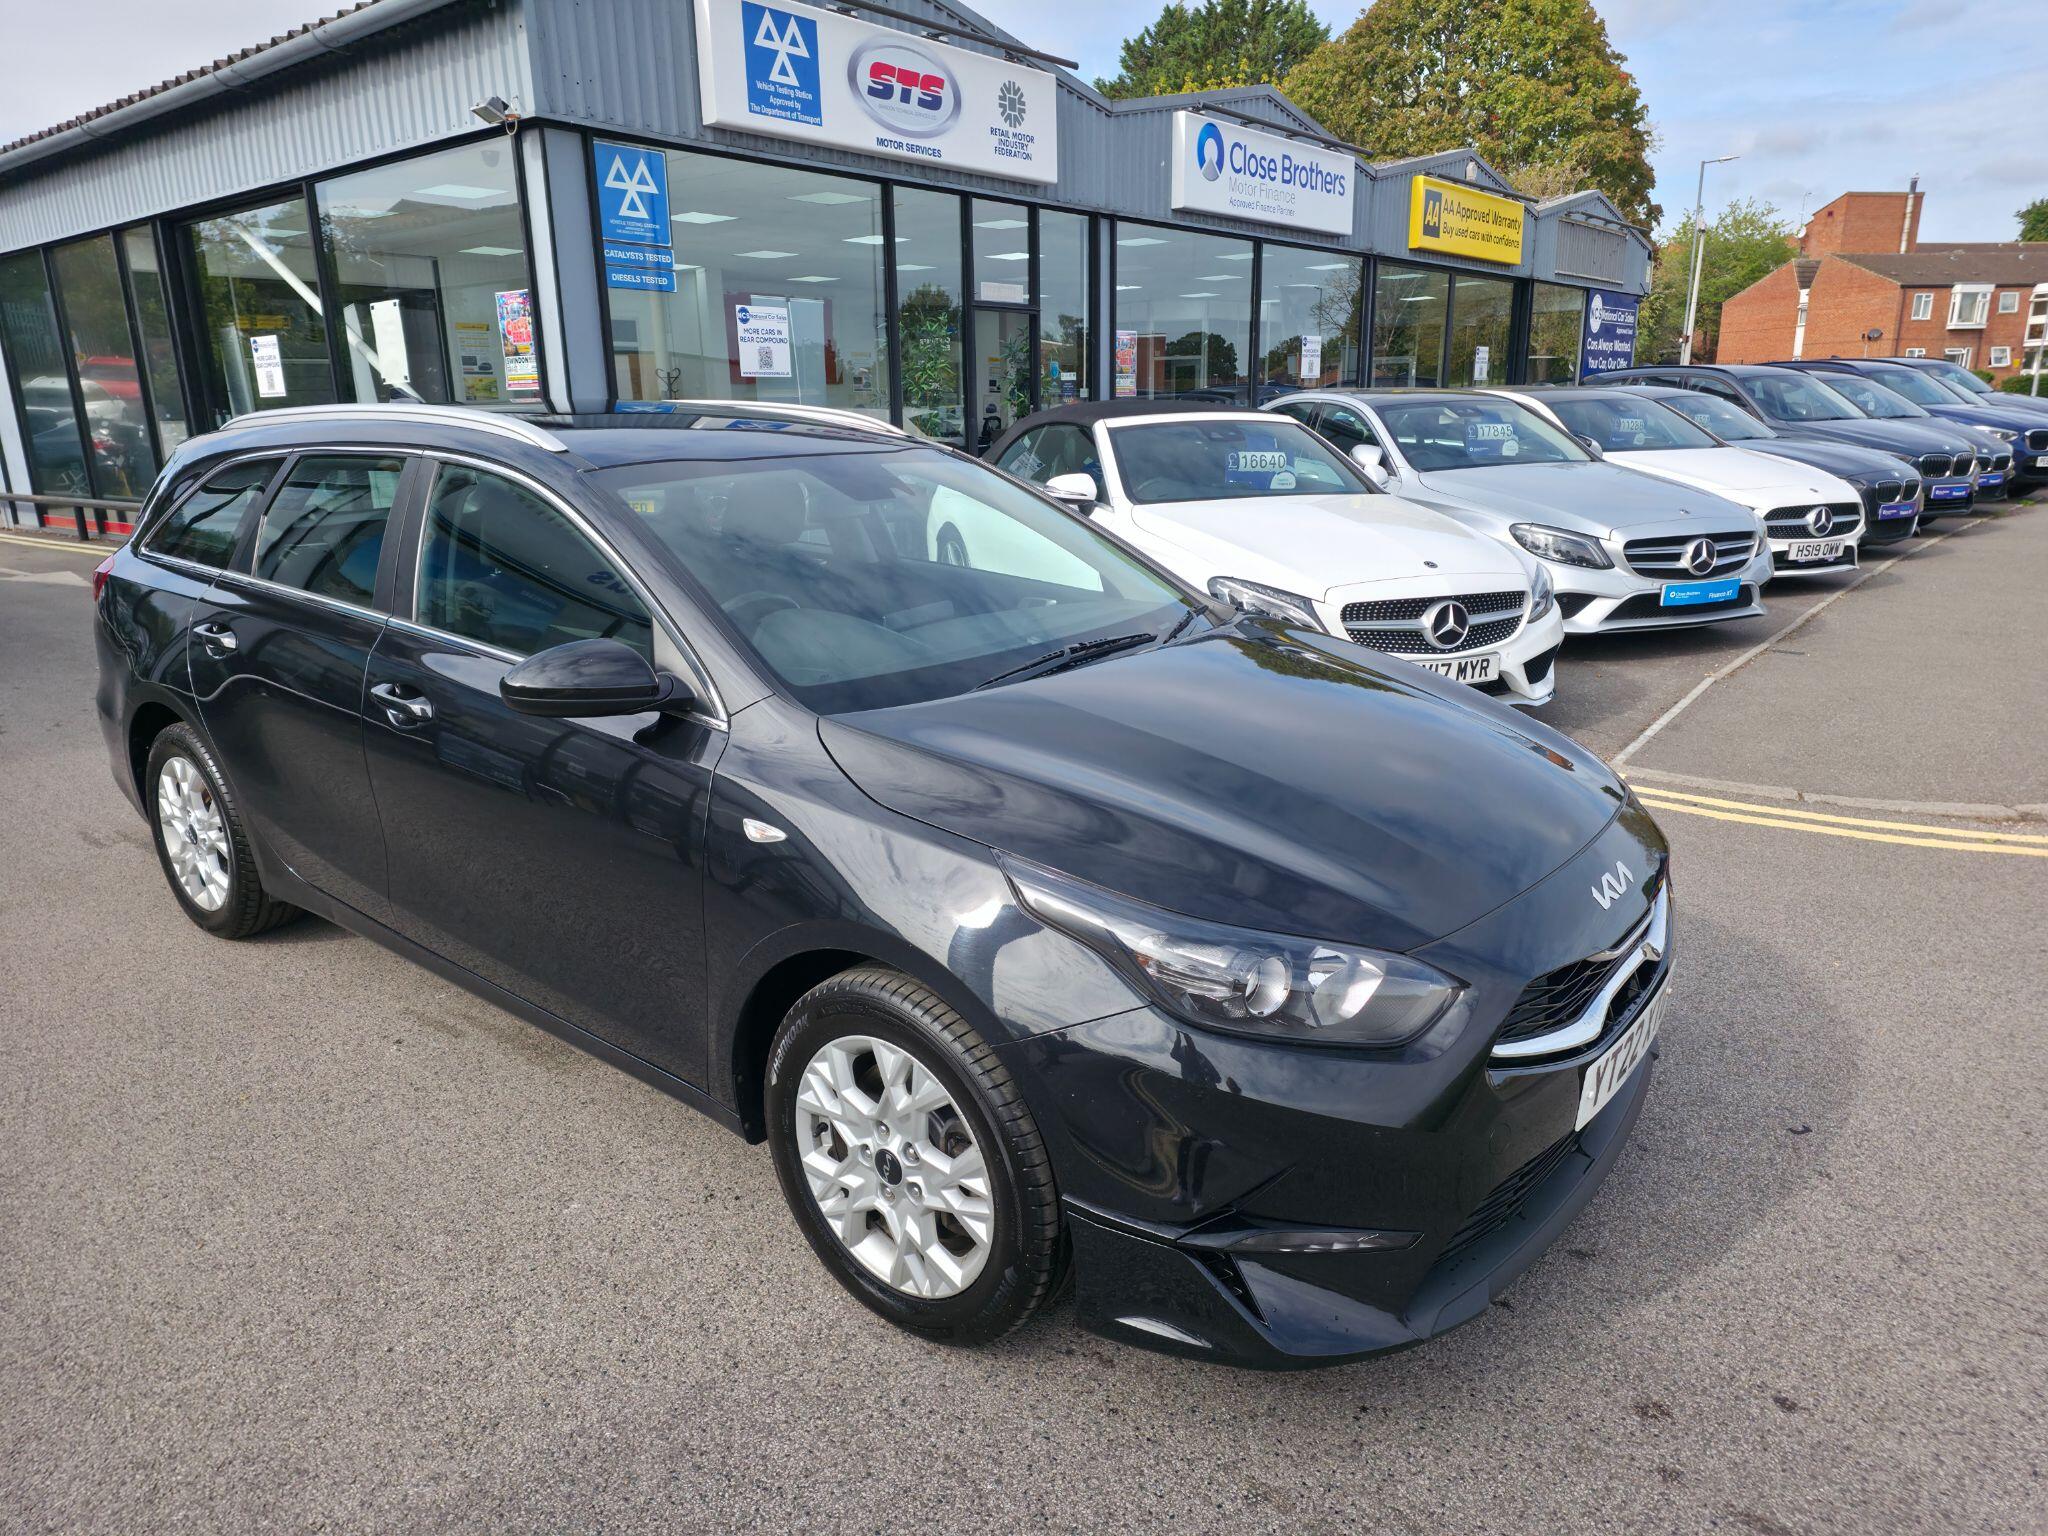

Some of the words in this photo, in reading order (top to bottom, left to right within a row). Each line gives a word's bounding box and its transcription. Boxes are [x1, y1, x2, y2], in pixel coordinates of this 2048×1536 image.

[756, 80, 775, 92] Vehicle
[776, 85, 795, 98] Testing
[795, 89, 813, 100] Station
[867, 61, 945, 111] STS
[769, 95, 794, 108] Approved
[795, 101, 802, 110] by
[750, 103, 761, 112] The
[761, 105, 791, 118] Department
[798, 113, 821, 124] Transport
[990, 126, 1010, 139] RETAIL
[1012, 132, 1035, 144] MOTOR
[876, 137, 904, 151] MOTOR
[905, 143, 942, 158] SERVICES
[994, 146, 1033, 161] FEDERATION
[998, 138, 1029, 151] INDUSTRY
[1229, 141, 1278, 182] Close
[1281, 153, 1346, 197] Brothers
[1229, 176, 1257, 198] Motor
[1259, 183, 1296, 205] Finance
[1229, 196, 1255, 210] Approved
[1255, 201, 1276, 214] Finance
[1277, 205, 1297, 217] Partner
[1424, 199, 1440, 228] AA
[1443, 198, 1455, 216] AA
[1456, 201, 1490, 224] Approved
[1491, 210, 1522, 235] Warranty
[1442, 221, 1454, 239] Buy
[1455, 227, 1469, 239] used
[1469, 230, 1480, 241] cars
[1481, 230, 1492, 243] with
[1493, 235, 1520, 249] confidence
[604, 249, 644, 261] CATALYSTS
[645, 253, 672, 263] TESTED
[611, 273, 640, 283] DIESELS
[642, 276, 668, 285] TESTED
[1602, 310, 1617, 321] National
[1625, 312, 1635, 323] Sales
[756, 336, 788, 344] COMPOUND
[761, 328, 776, 336] CARS
[1587, 338, 1598, 351] Cars
[1598, 338, 1613, 353] Always
[1588, 356, 1599, 369] Your
[1608, 358, 1616, 369] Our
[1796, 544, 1821, 558] HS19
[1456, 658, 1490, 681] MYR
